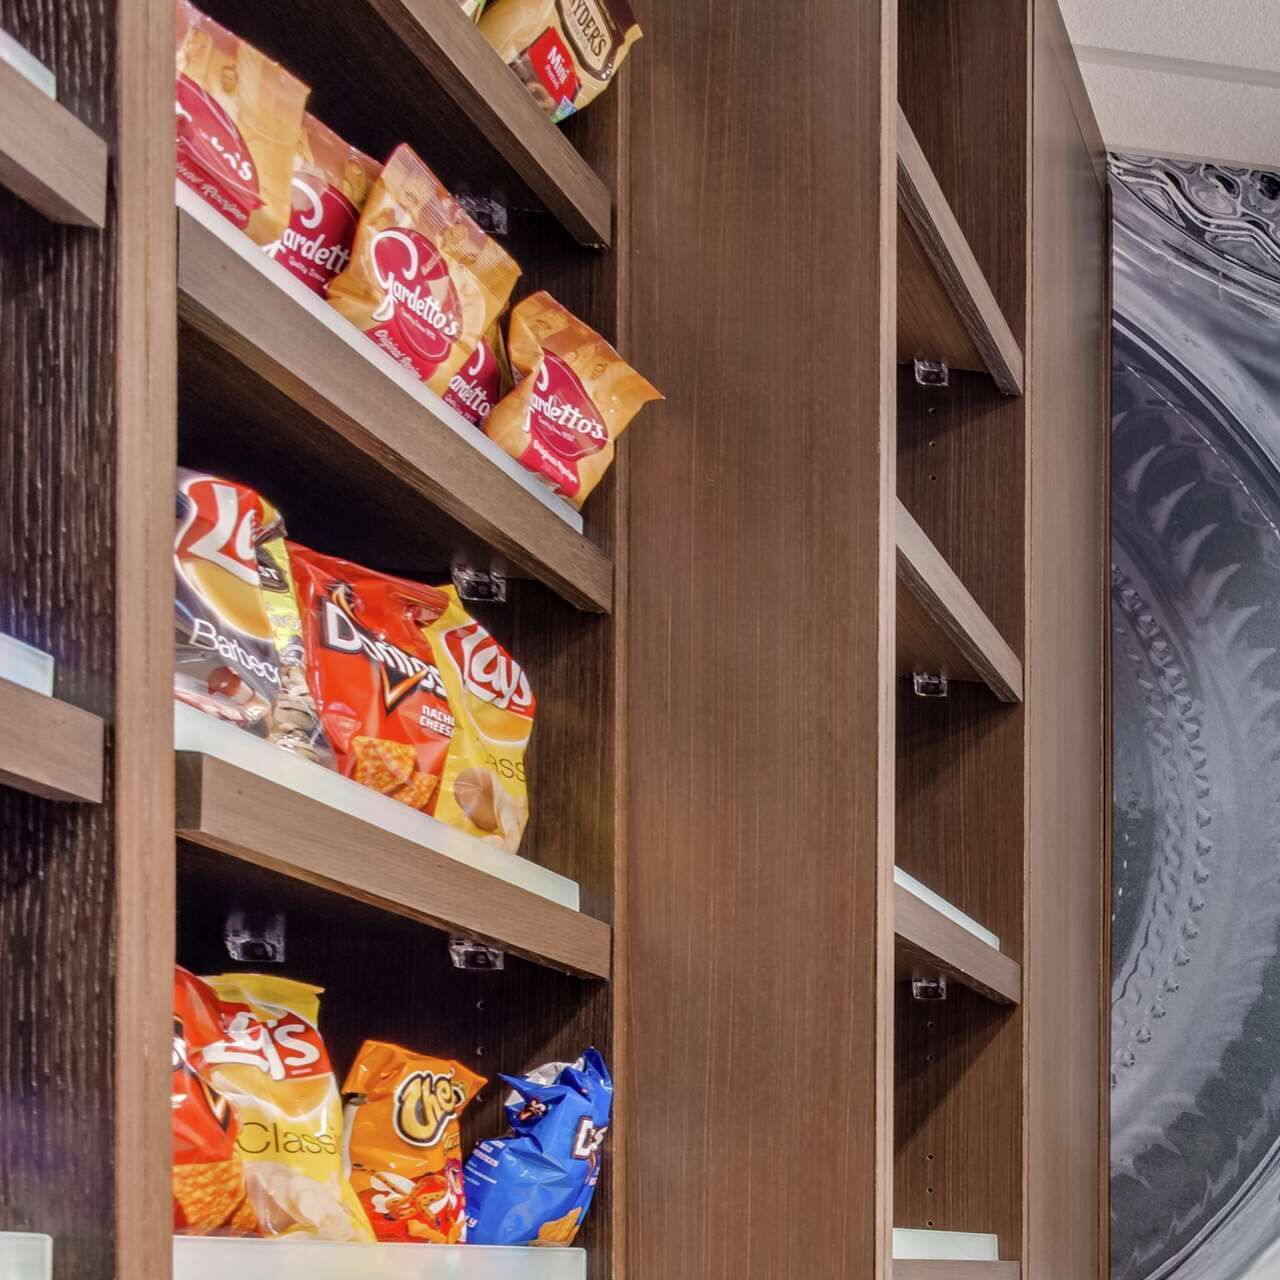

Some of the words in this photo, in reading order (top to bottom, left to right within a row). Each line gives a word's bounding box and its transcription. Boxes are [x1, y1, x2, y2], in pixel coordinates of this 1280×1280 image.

[547, 46, 569, 85] Mini
[371, 230, 460, 337] Gardetto's
[461, 625, 532, 710] Lay's
[236, 1121, 340, 1156] Class
